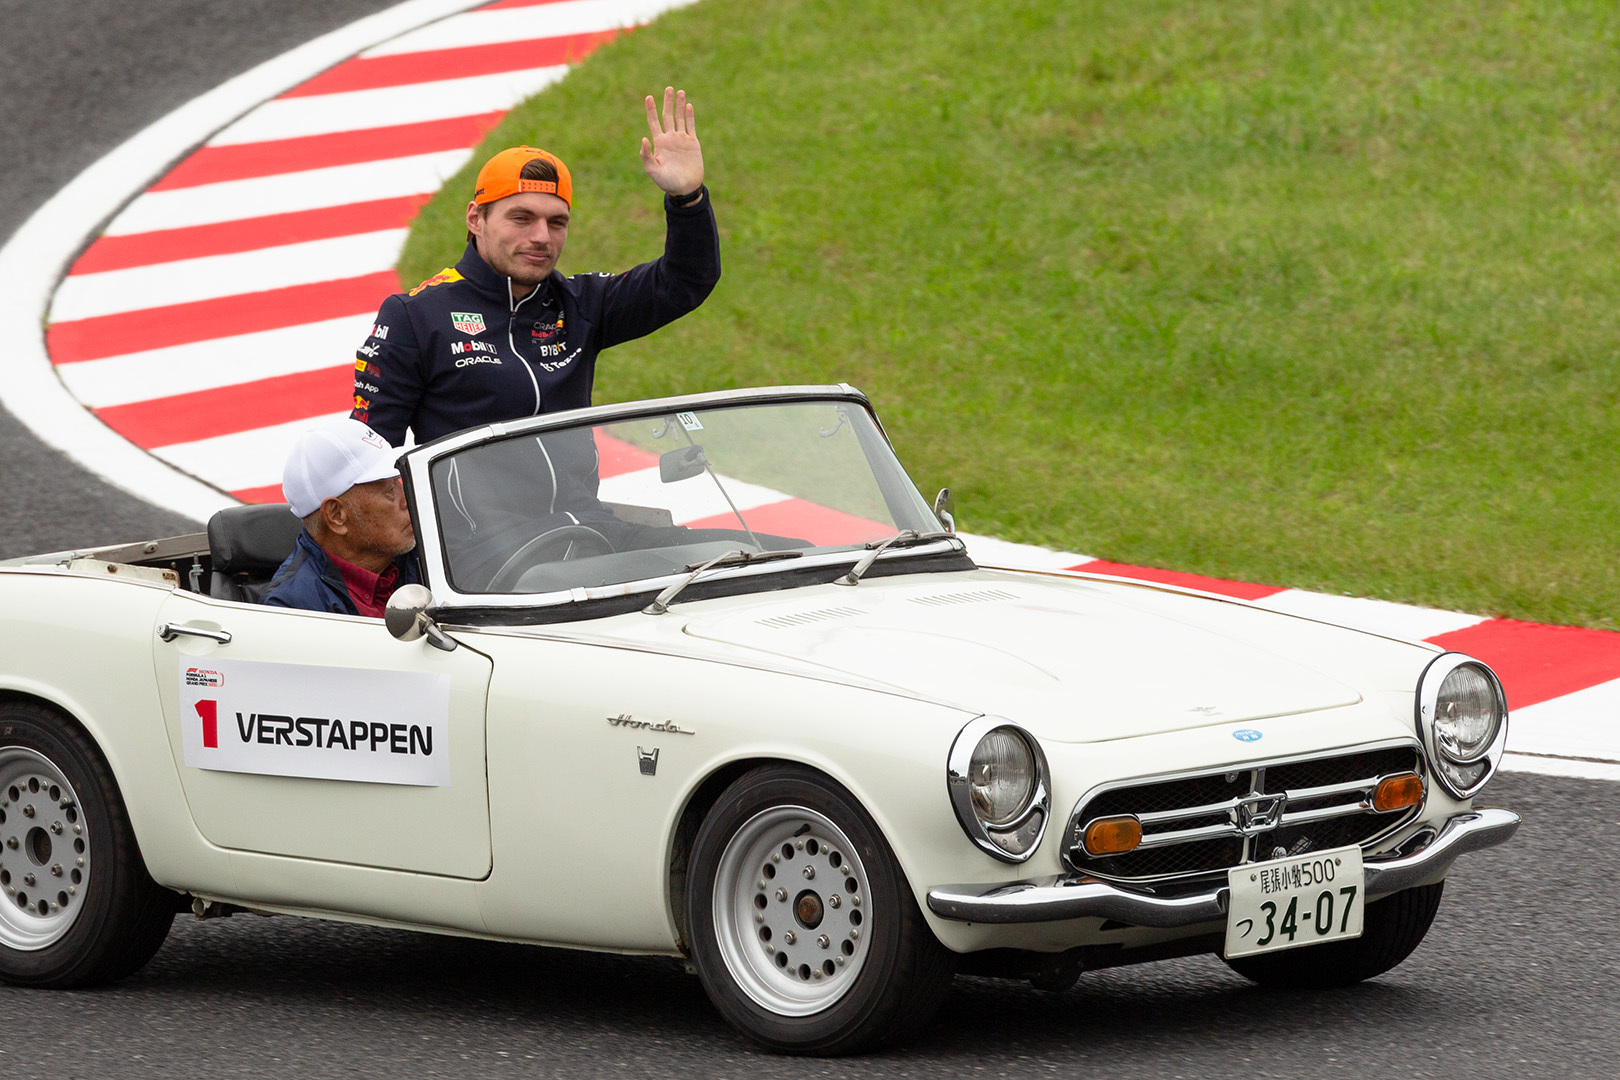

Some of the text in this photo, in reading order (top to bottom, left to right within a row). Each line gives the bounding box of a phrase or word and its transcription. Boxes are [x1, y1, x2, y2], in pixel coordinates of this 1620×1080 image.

[454, 314, 481, 323] TAG
[451, 340, 487, 355] Mobil
[540, 341, 567, 357] BYBIT
[455, 355, 503, 368] ORACLE
[364, 383, 380, 393] App
[680, 413, 693, 425] 10
[194, 699, 433, 756] 1 VERSTAPPEN
[606, 713, 695, 735] Honda
[1236, 885, 1357, 946] つ 34-07
